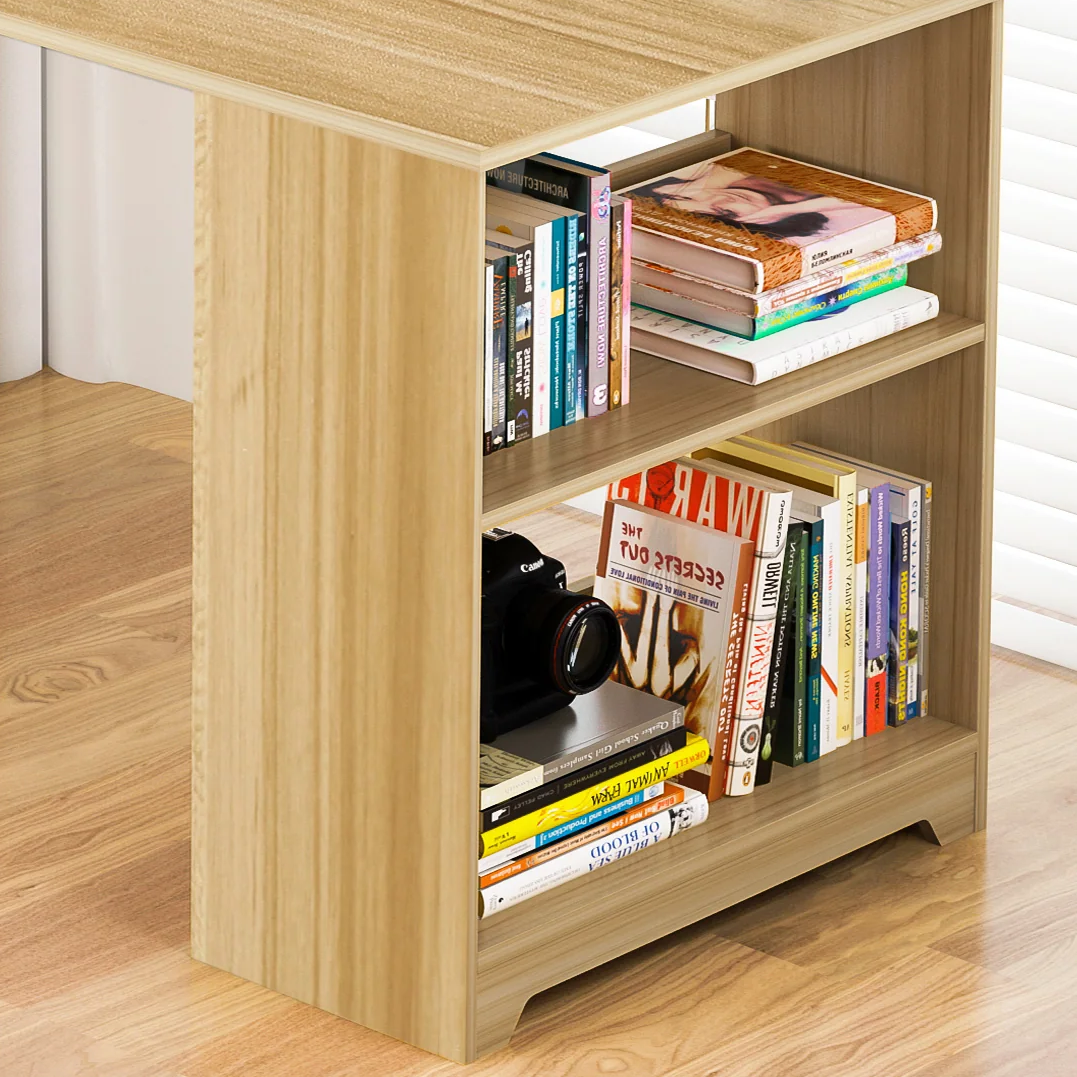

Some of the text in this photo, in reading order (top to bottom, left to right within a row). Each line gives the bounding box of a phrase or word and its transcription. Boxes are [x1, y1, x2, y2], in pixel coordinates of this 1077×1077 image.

[811, 250, 828, 261] ЮЛИЯ
[520, 558, 545, 574] Canon
[560, 720, 669, 769] Quaker School Girl Samplers
[564, 751, 646, 789] AWAY FROM EVERYWHERE
[590, 750, 706, 806] ORWELL ANIMAL FARM
[513, 790, 556, 810] CHAD PELLEY
[656, 798, 675, 810] Blind
[548, 797, 634, 840] Business and Production
[611, 819, 624, 829] See
[629, 812, 643, 821] Now
[642, 821, 660, 836] OF
[590, 830, 638, 859] BLOOD
[615, 838, 648, 860] BLUE
[588, 854, 611, 871] SEA
